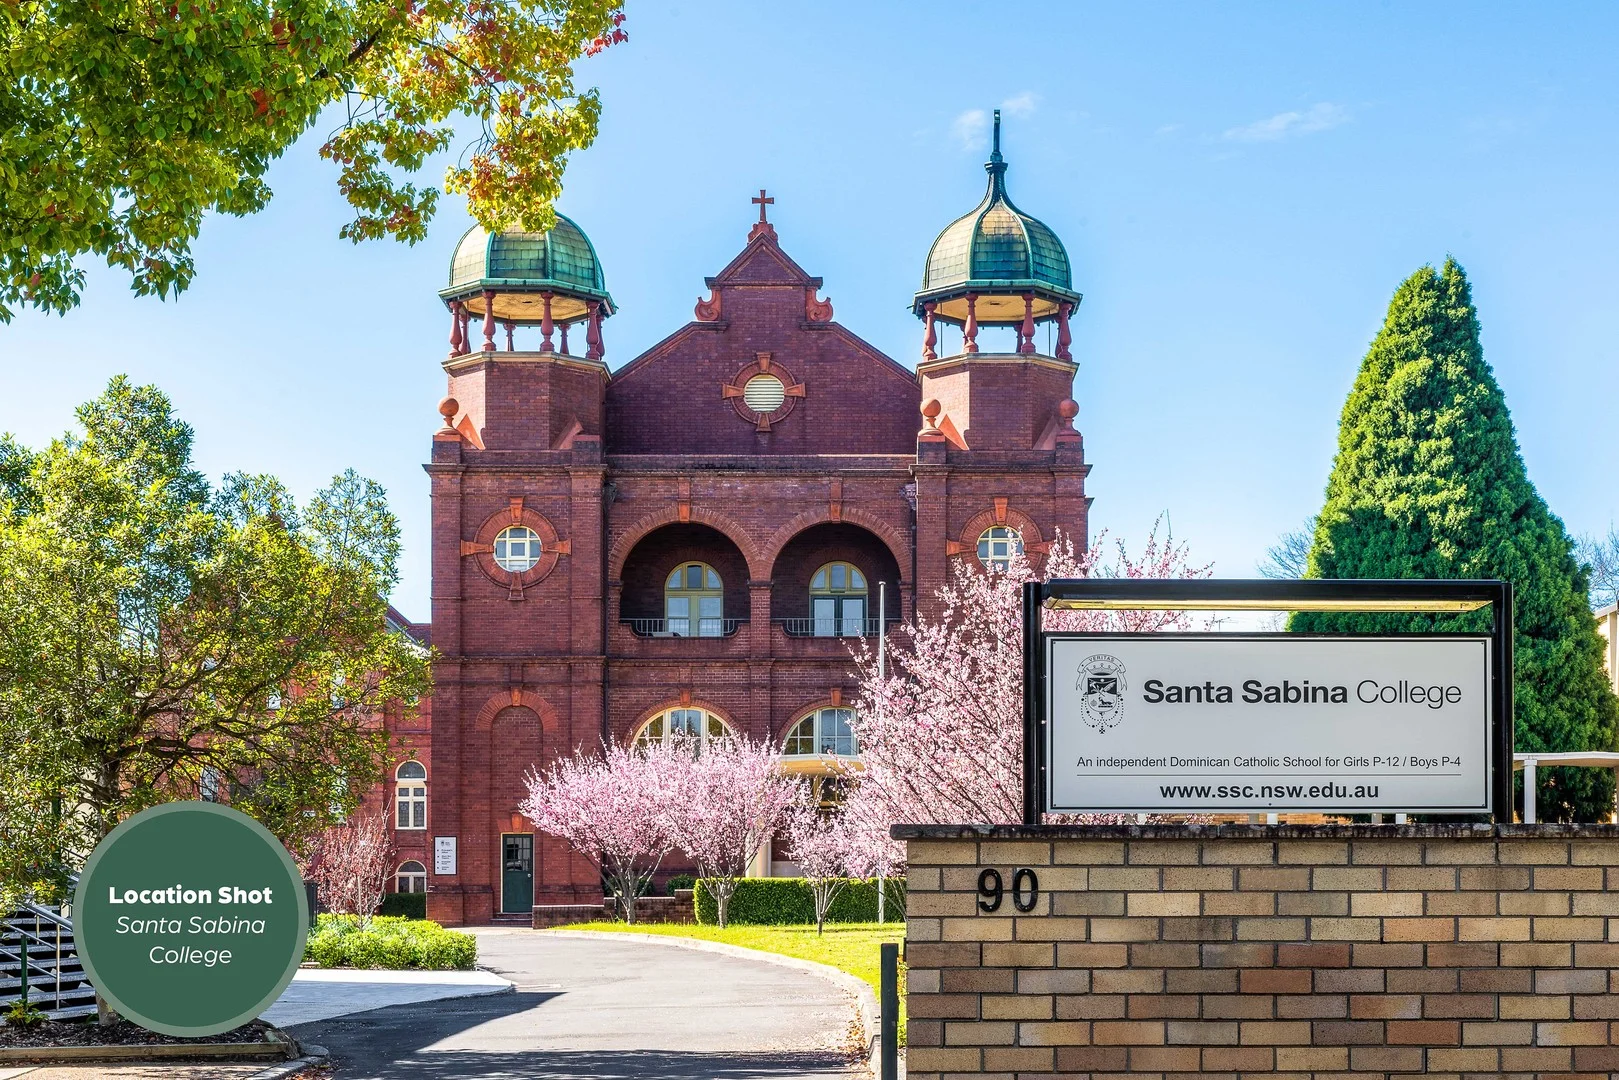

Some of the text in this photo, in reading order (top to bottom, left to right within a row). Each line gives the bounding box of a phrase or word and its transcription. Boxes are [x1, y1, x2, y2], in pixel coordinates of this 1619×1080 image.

[1088, 655, 1115, 663] VERITAS
[1143, 679, 1462, 710] Santa Sabina College
[1077, 756, 1461, 770] An independent Dominican Catholic School for Girls P-12 / Boys P-4
[1159, 782, 1379, 799] www.ssc.nsw.edu.au
[978, 868, 1038, 912] 90
